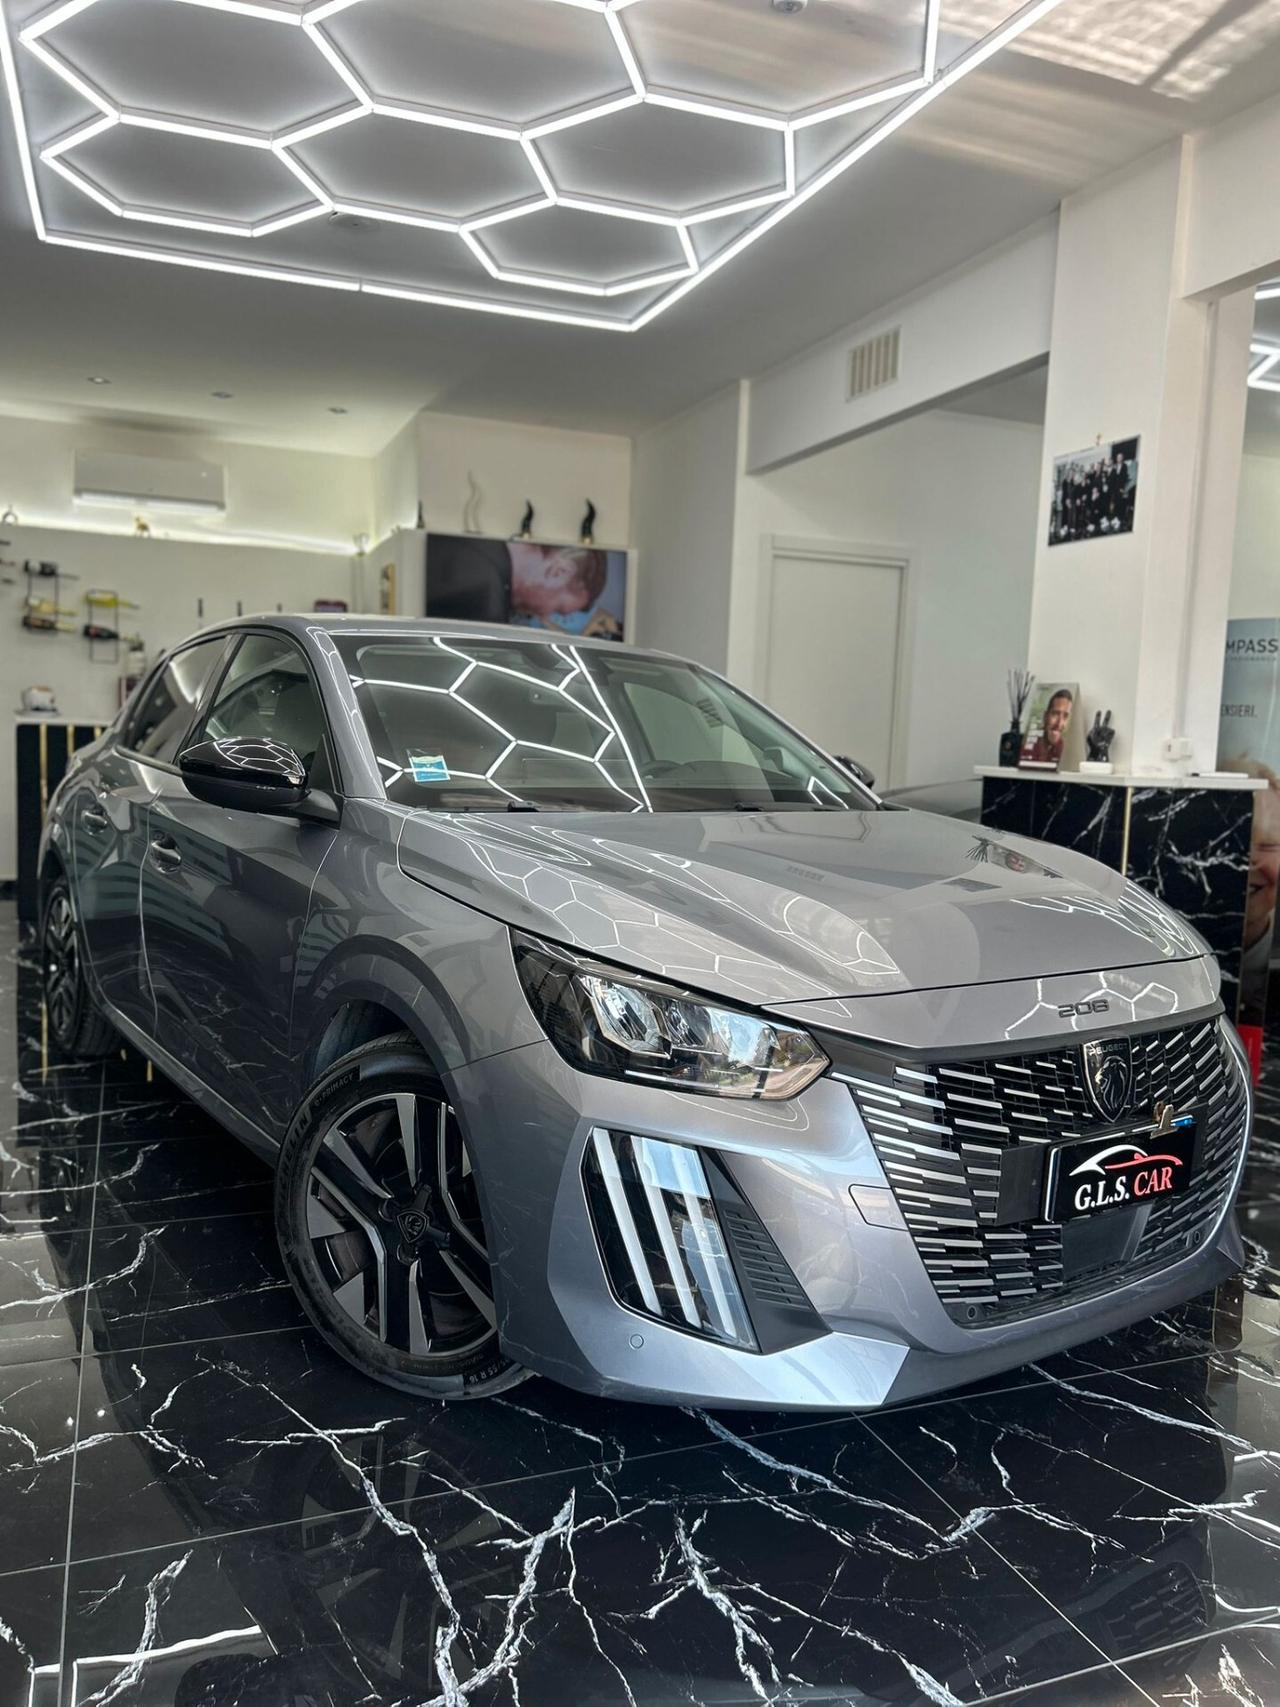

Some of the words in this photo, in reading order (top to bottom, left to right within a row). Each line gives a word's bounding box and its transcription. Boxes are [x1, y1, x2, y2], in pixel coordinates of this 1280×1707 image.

[1057, 999, 1109, 1018] 208
[1074, 1175, 1130, 1211] G.L.S.
[1133, 1166, 1173, 1196] CAR
